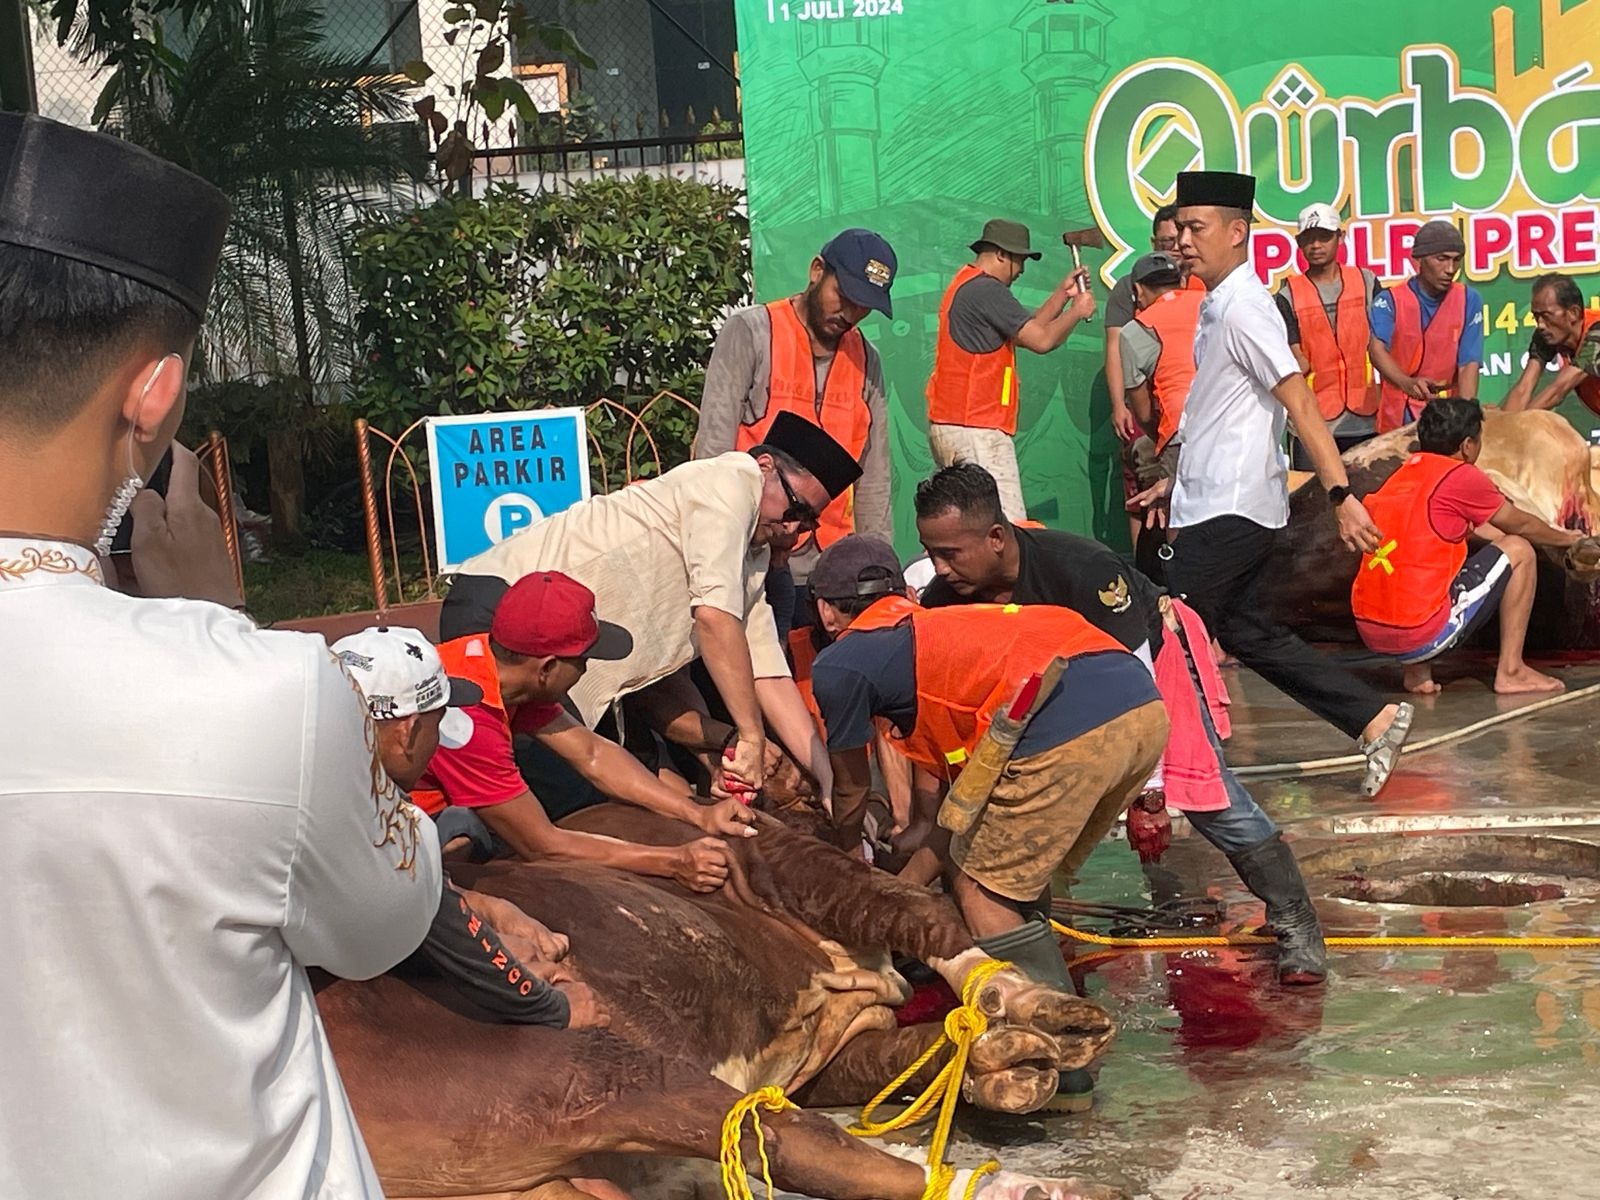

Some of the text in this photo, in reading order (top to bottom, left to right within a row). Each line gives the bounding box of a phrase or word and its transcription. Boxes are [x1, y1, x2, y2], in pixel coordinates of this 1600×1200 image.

[797, 0, 845, 21] JULI
[851, 0, 904, 18] 2024
[468, 424, 547, 455] AREA
[453, 456, 566, 488] PARKIR
[500, 504, 532, 541] P
